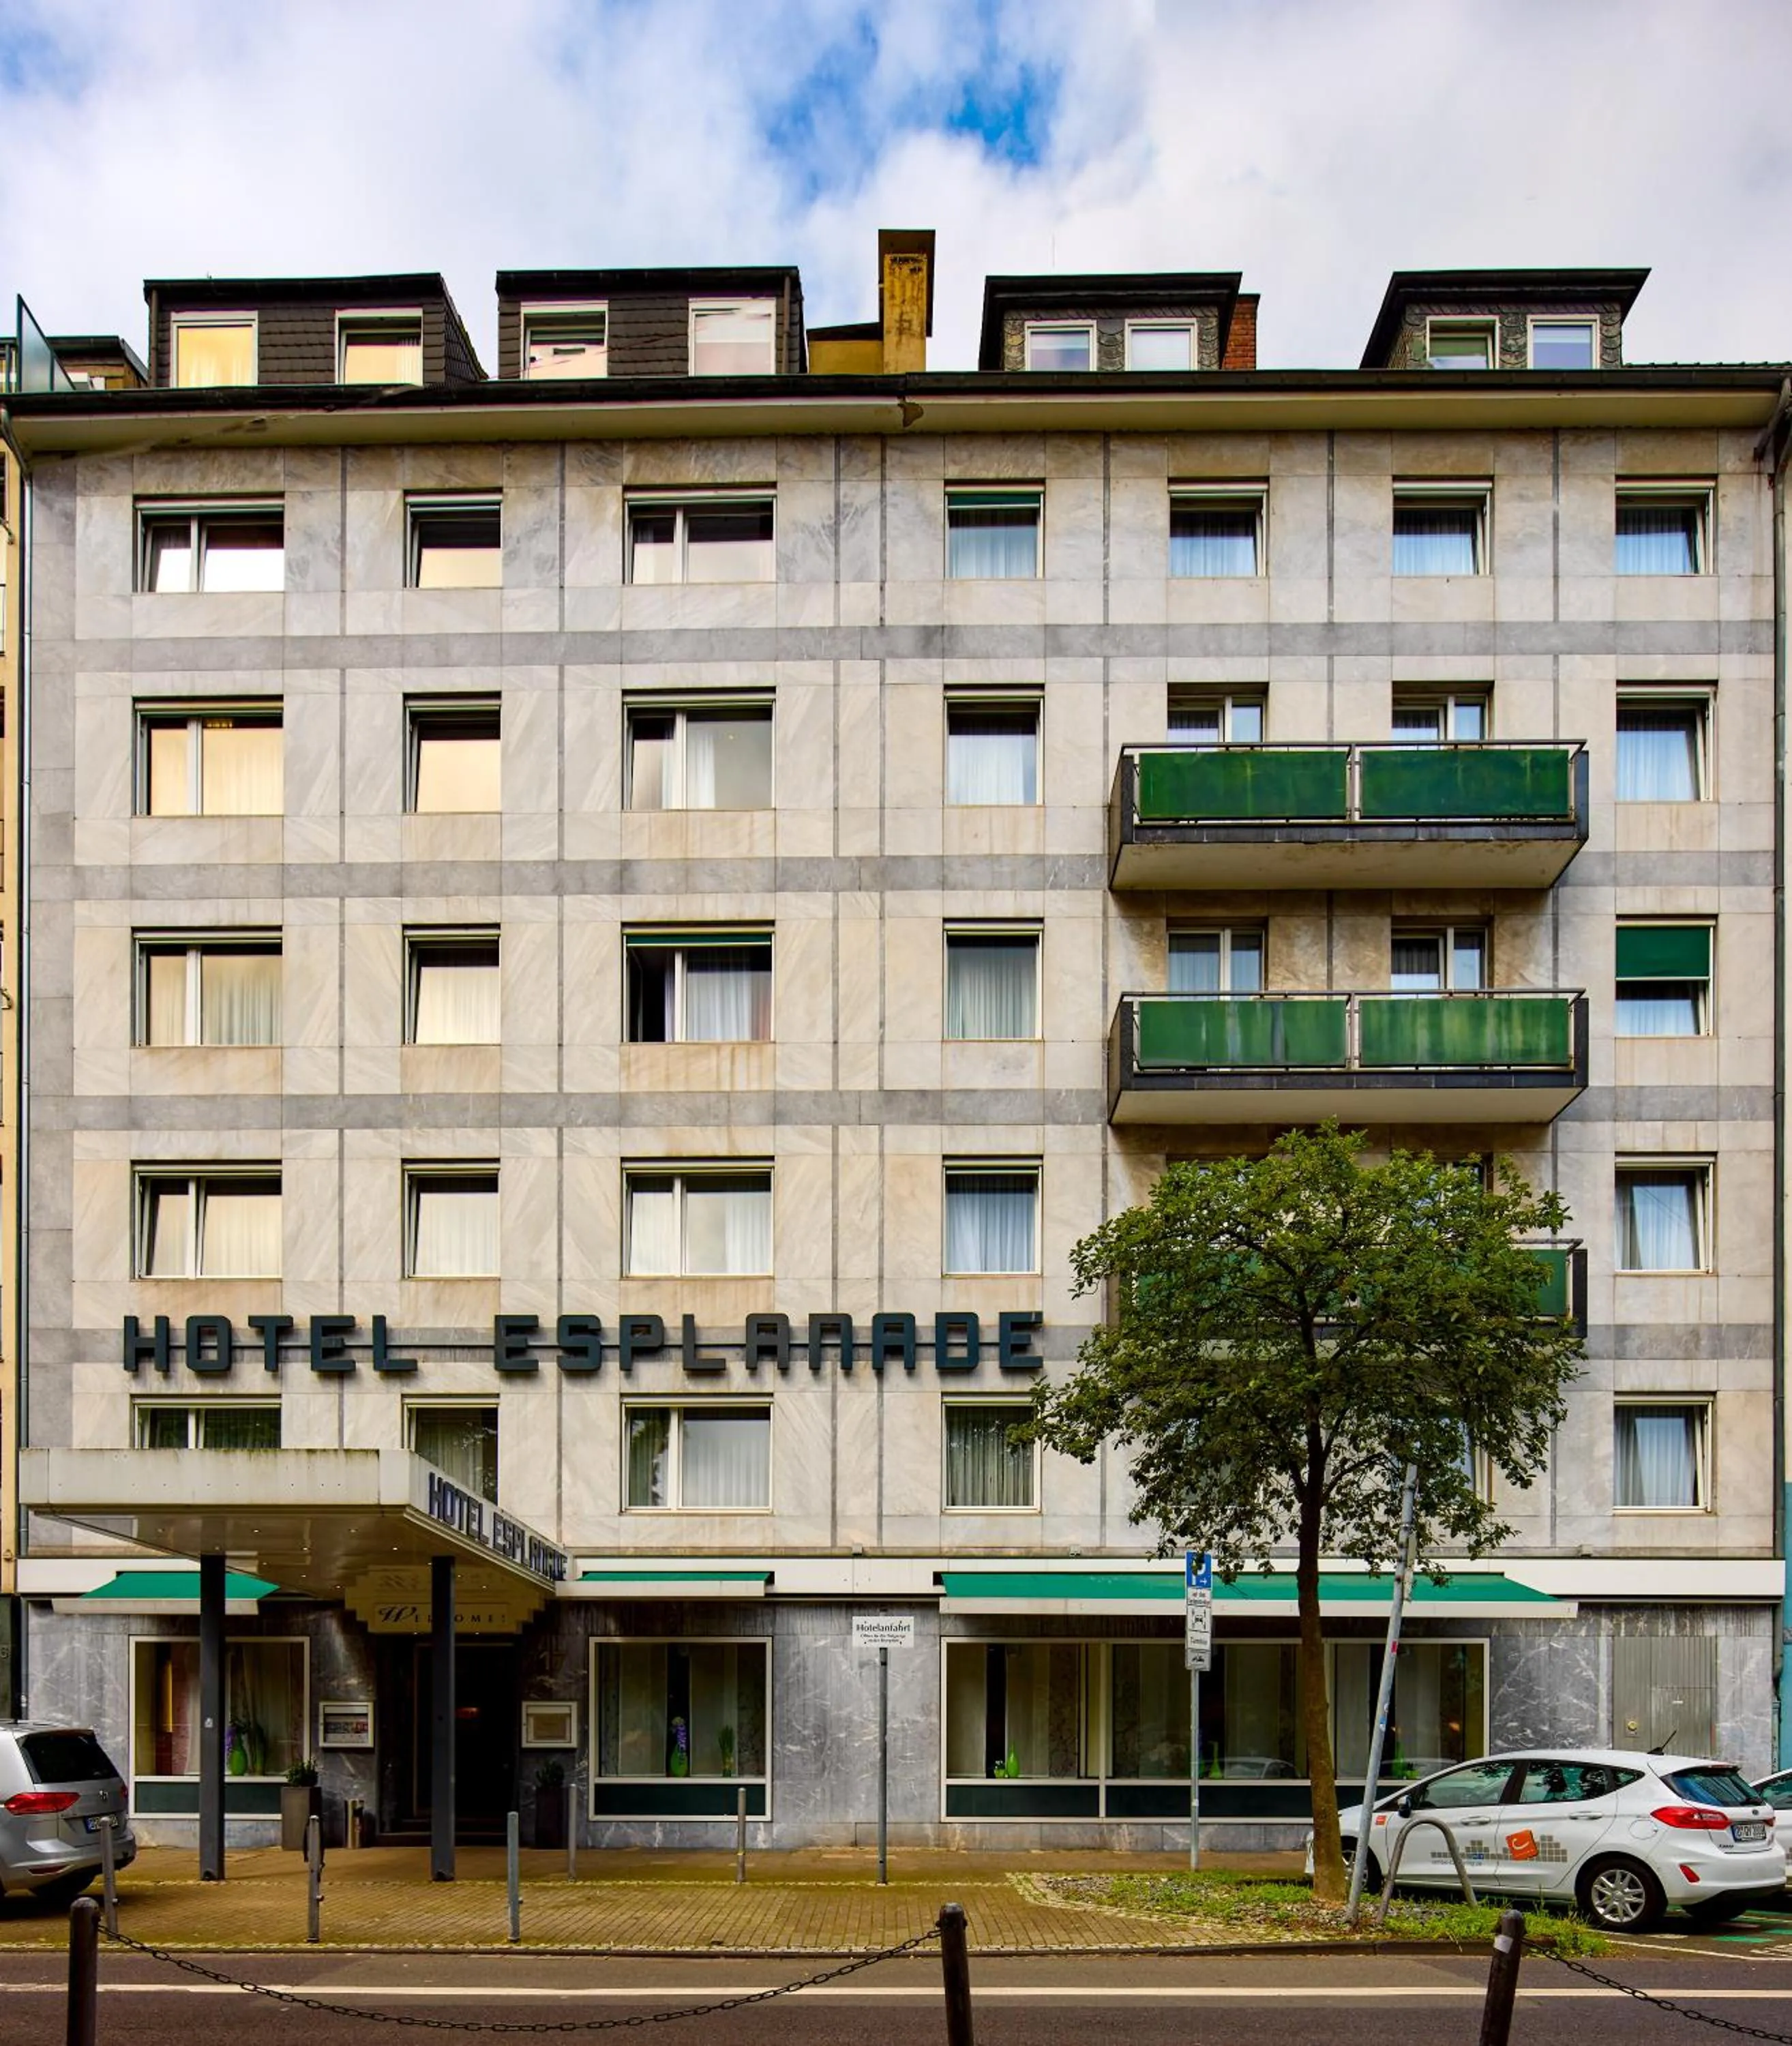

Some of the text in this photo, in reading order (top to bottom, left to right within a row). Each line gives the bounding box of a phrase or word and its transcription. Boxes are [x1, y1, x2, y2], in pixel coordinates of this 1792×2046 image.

[123, 1311, 1043, 1372] HOTEL ESPLANADE
[429, 1471, 489, 1545] HOTEL
[856, 1622, 911, 1632] Hotelanfahrt
